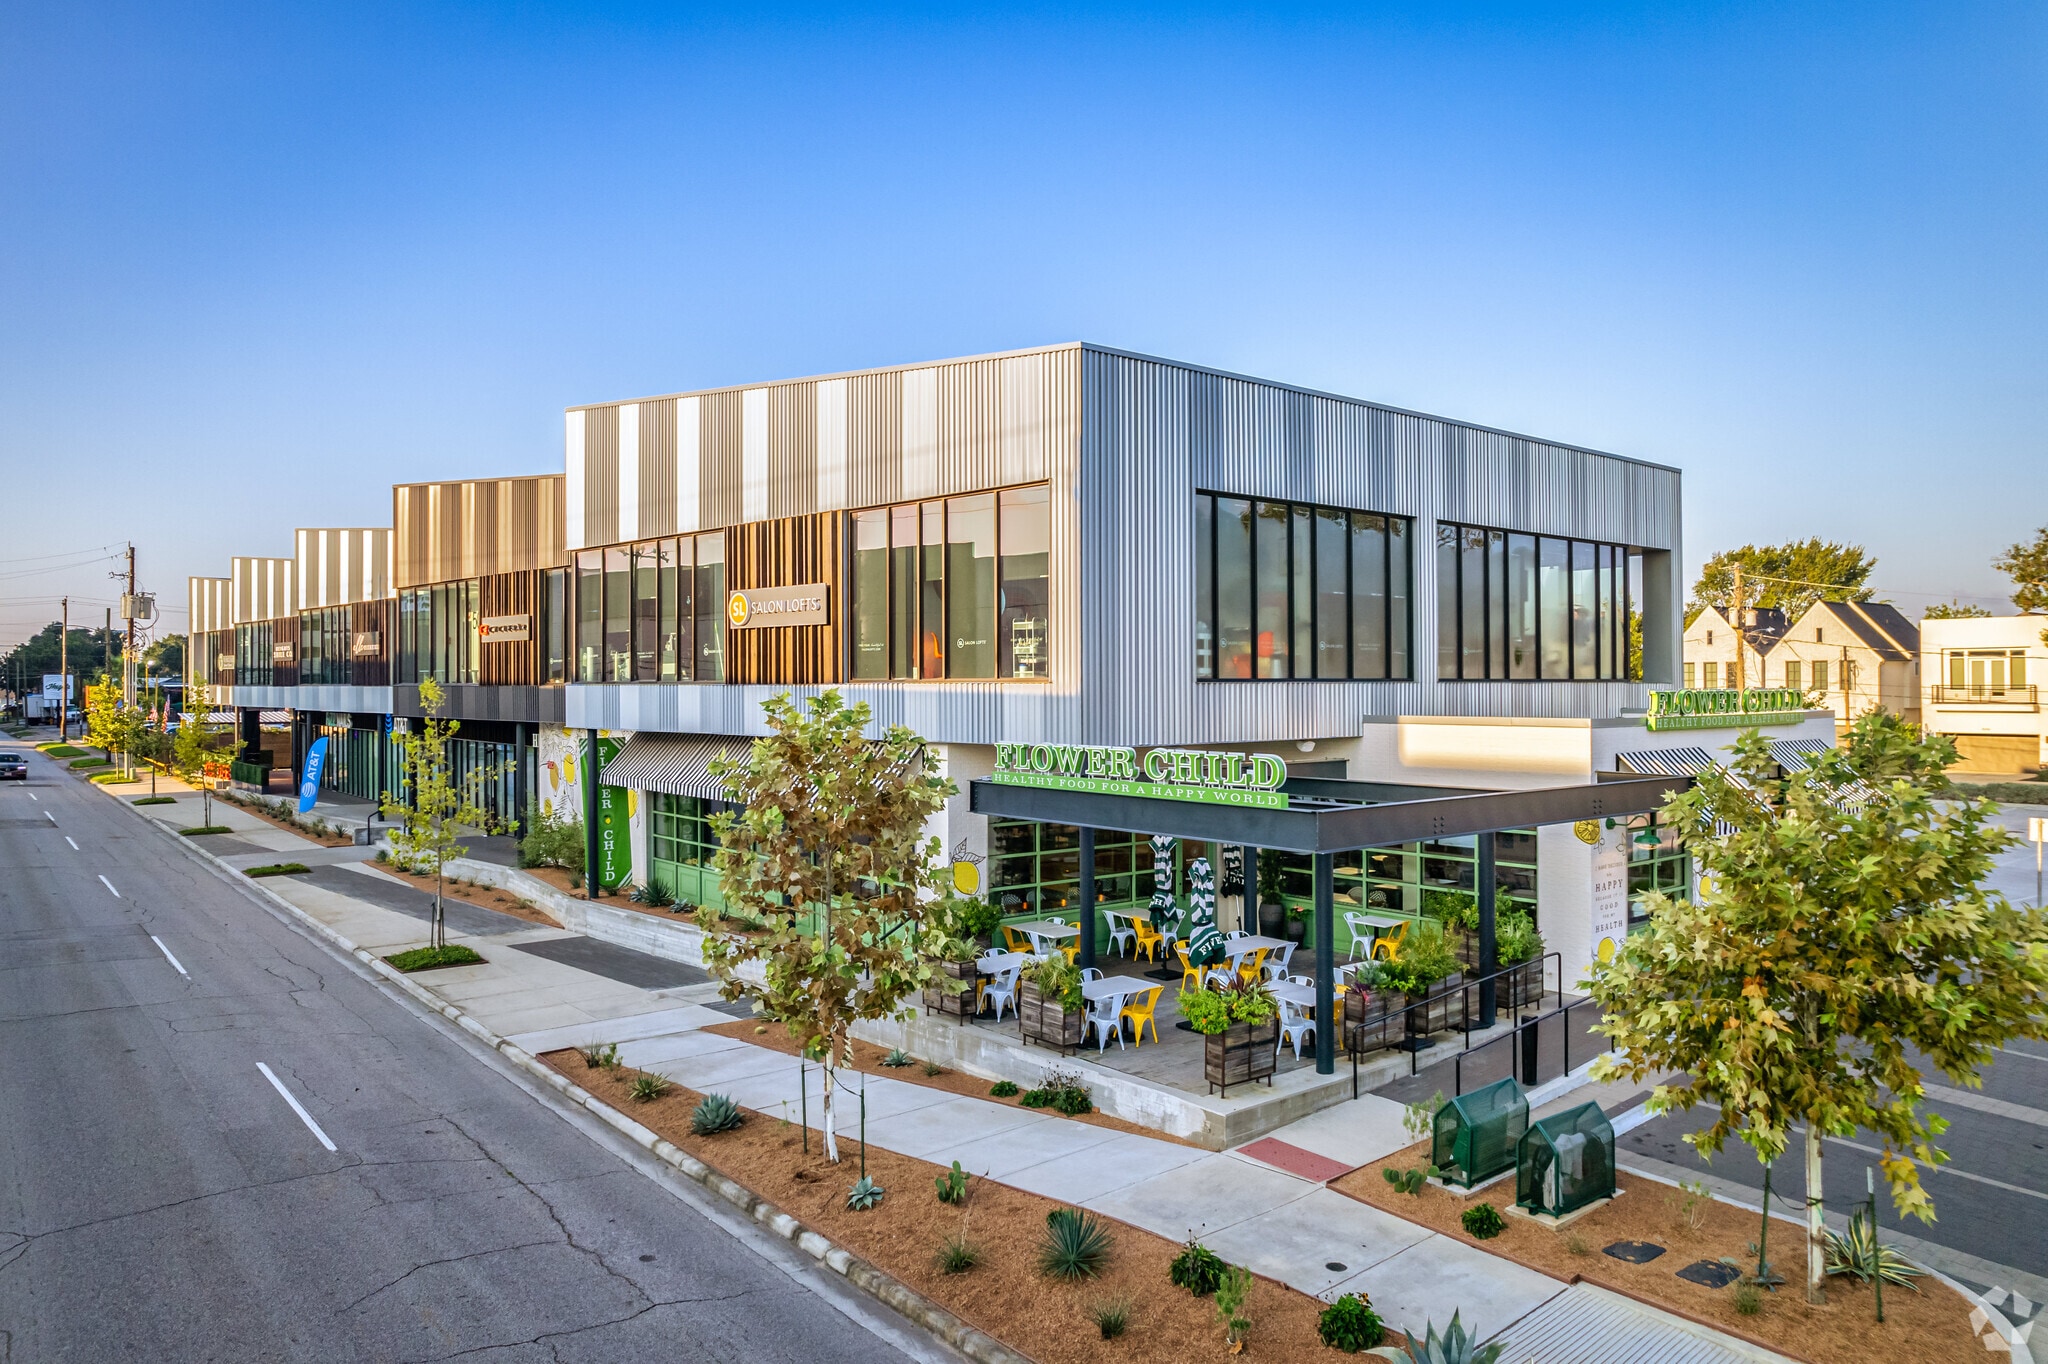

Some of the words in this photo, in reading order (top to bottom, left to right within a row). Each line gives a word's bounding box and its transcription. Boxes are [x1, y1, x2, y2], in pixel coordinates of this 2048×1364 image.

[732, 601, 745, 617] SL
[751, 600, 783, 615] SALON
[786, 597, 818, 612] LOFTS
[1648, 689, 1740, 715] FLOWER
[1742, 688, 1803, 712] CHILD
[393, 717, 408, 734] AT&T
[1656, 716, 1698, 729] HEALTHY
[1701, 716, 1723, 727] FOOD
[1726, 715, 1741, 725] FOR
[1743, 715, 1749, 724] A
[1751, 714, 1777, 724] HAPPY
[307, 750, 320, 780] AT&T
[994, 742, 1140, 779] FLOWER
[1144, 748, 1287, 789] CHILD
[599, 746, 613, 809] FLER
[994, 773, 1053, 786] HEALTHY
[1059, 779, 1096, 790] FOOD
[1101, 782, 1130, 793] FOR
[1135, 785, 1146, 794] A
[1151, 786, 1206, 799] HAPPY
[1213, 791, 1279, 806] WORLD
[603, 829, 616, 881] CHILD
[1595, 879, 1624, 892] HAPPY
[1599, 901, 1619, 911] GOOD
[1595, 920, 1623, 933] HEALTH
